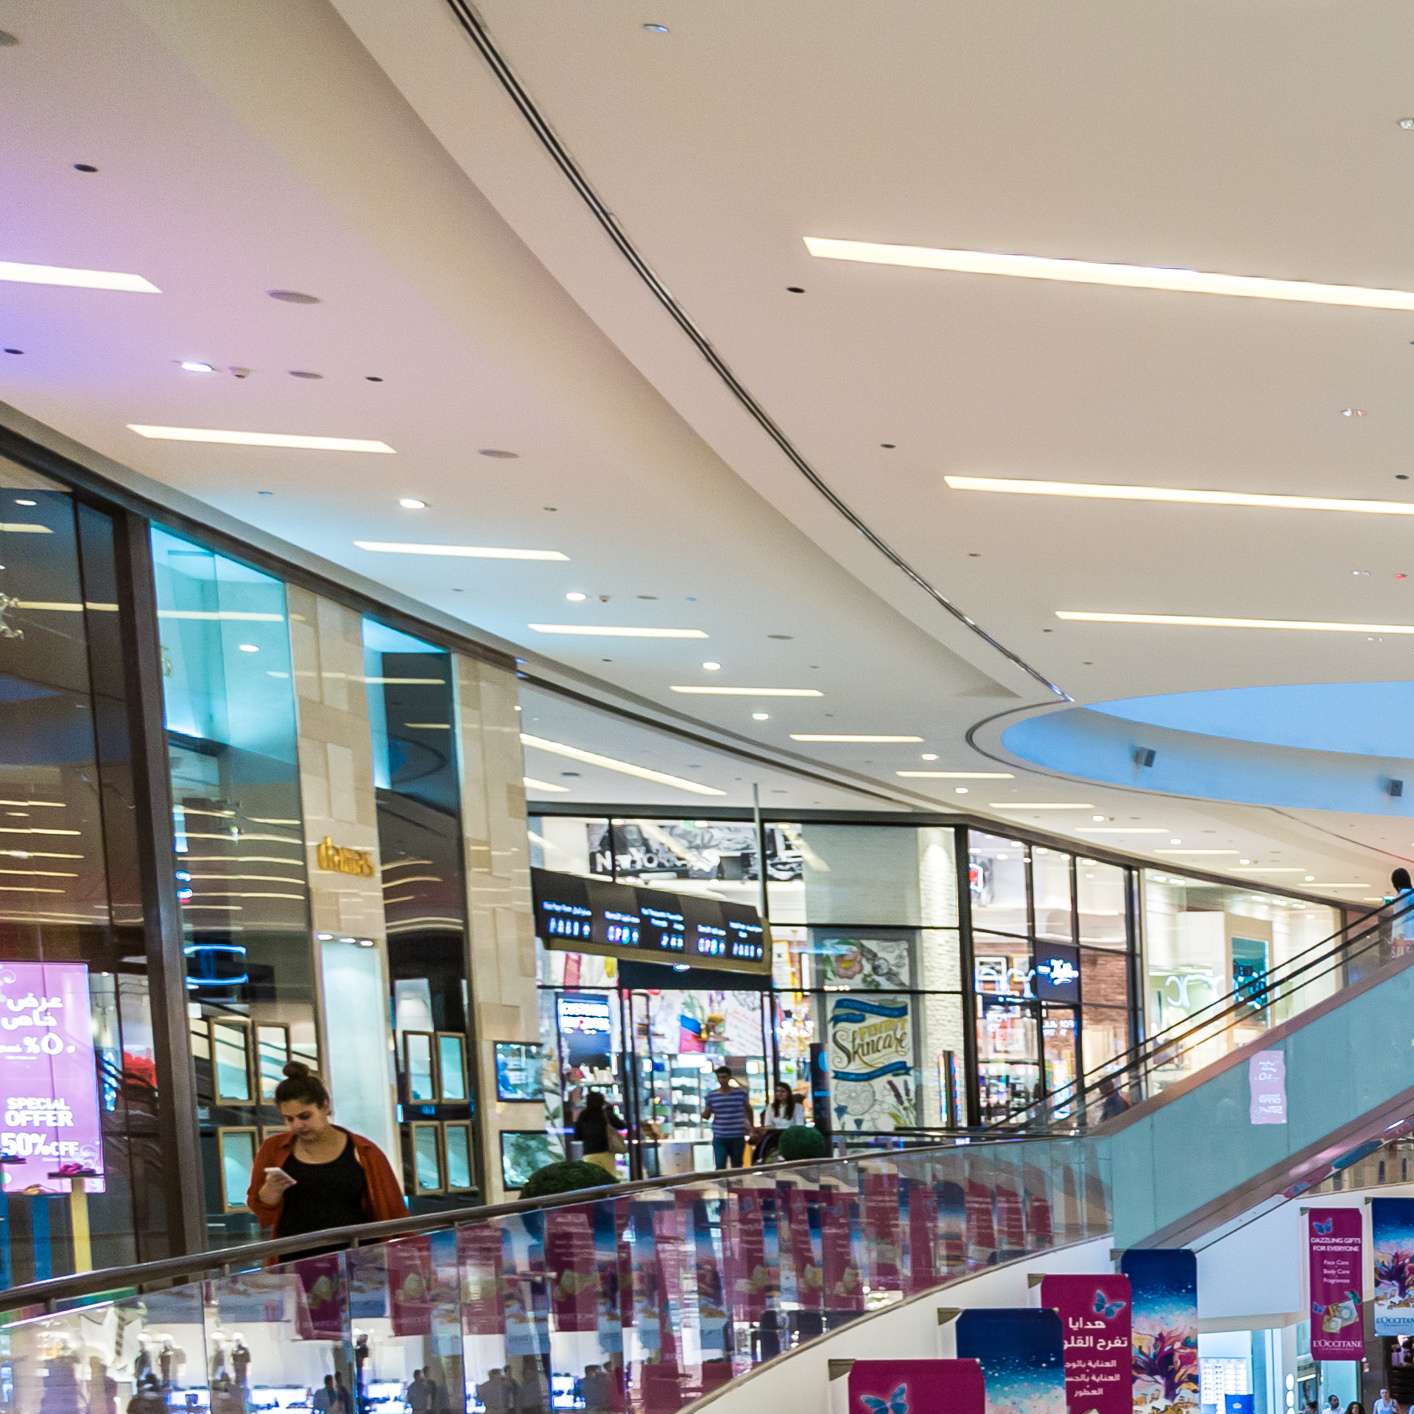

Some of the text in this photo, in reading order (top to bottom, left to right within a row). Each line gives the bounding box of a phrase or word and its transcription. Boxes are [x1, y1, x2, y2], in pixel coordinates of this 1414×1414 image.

[5, 1111, 74, 1127] OFFER
[1069, 1317, 1106, 1330] هدايا
[1097, 1337, 1128, 1350] تفرح
[1313, 1340, 1362, 1350] L'OCCITANE
